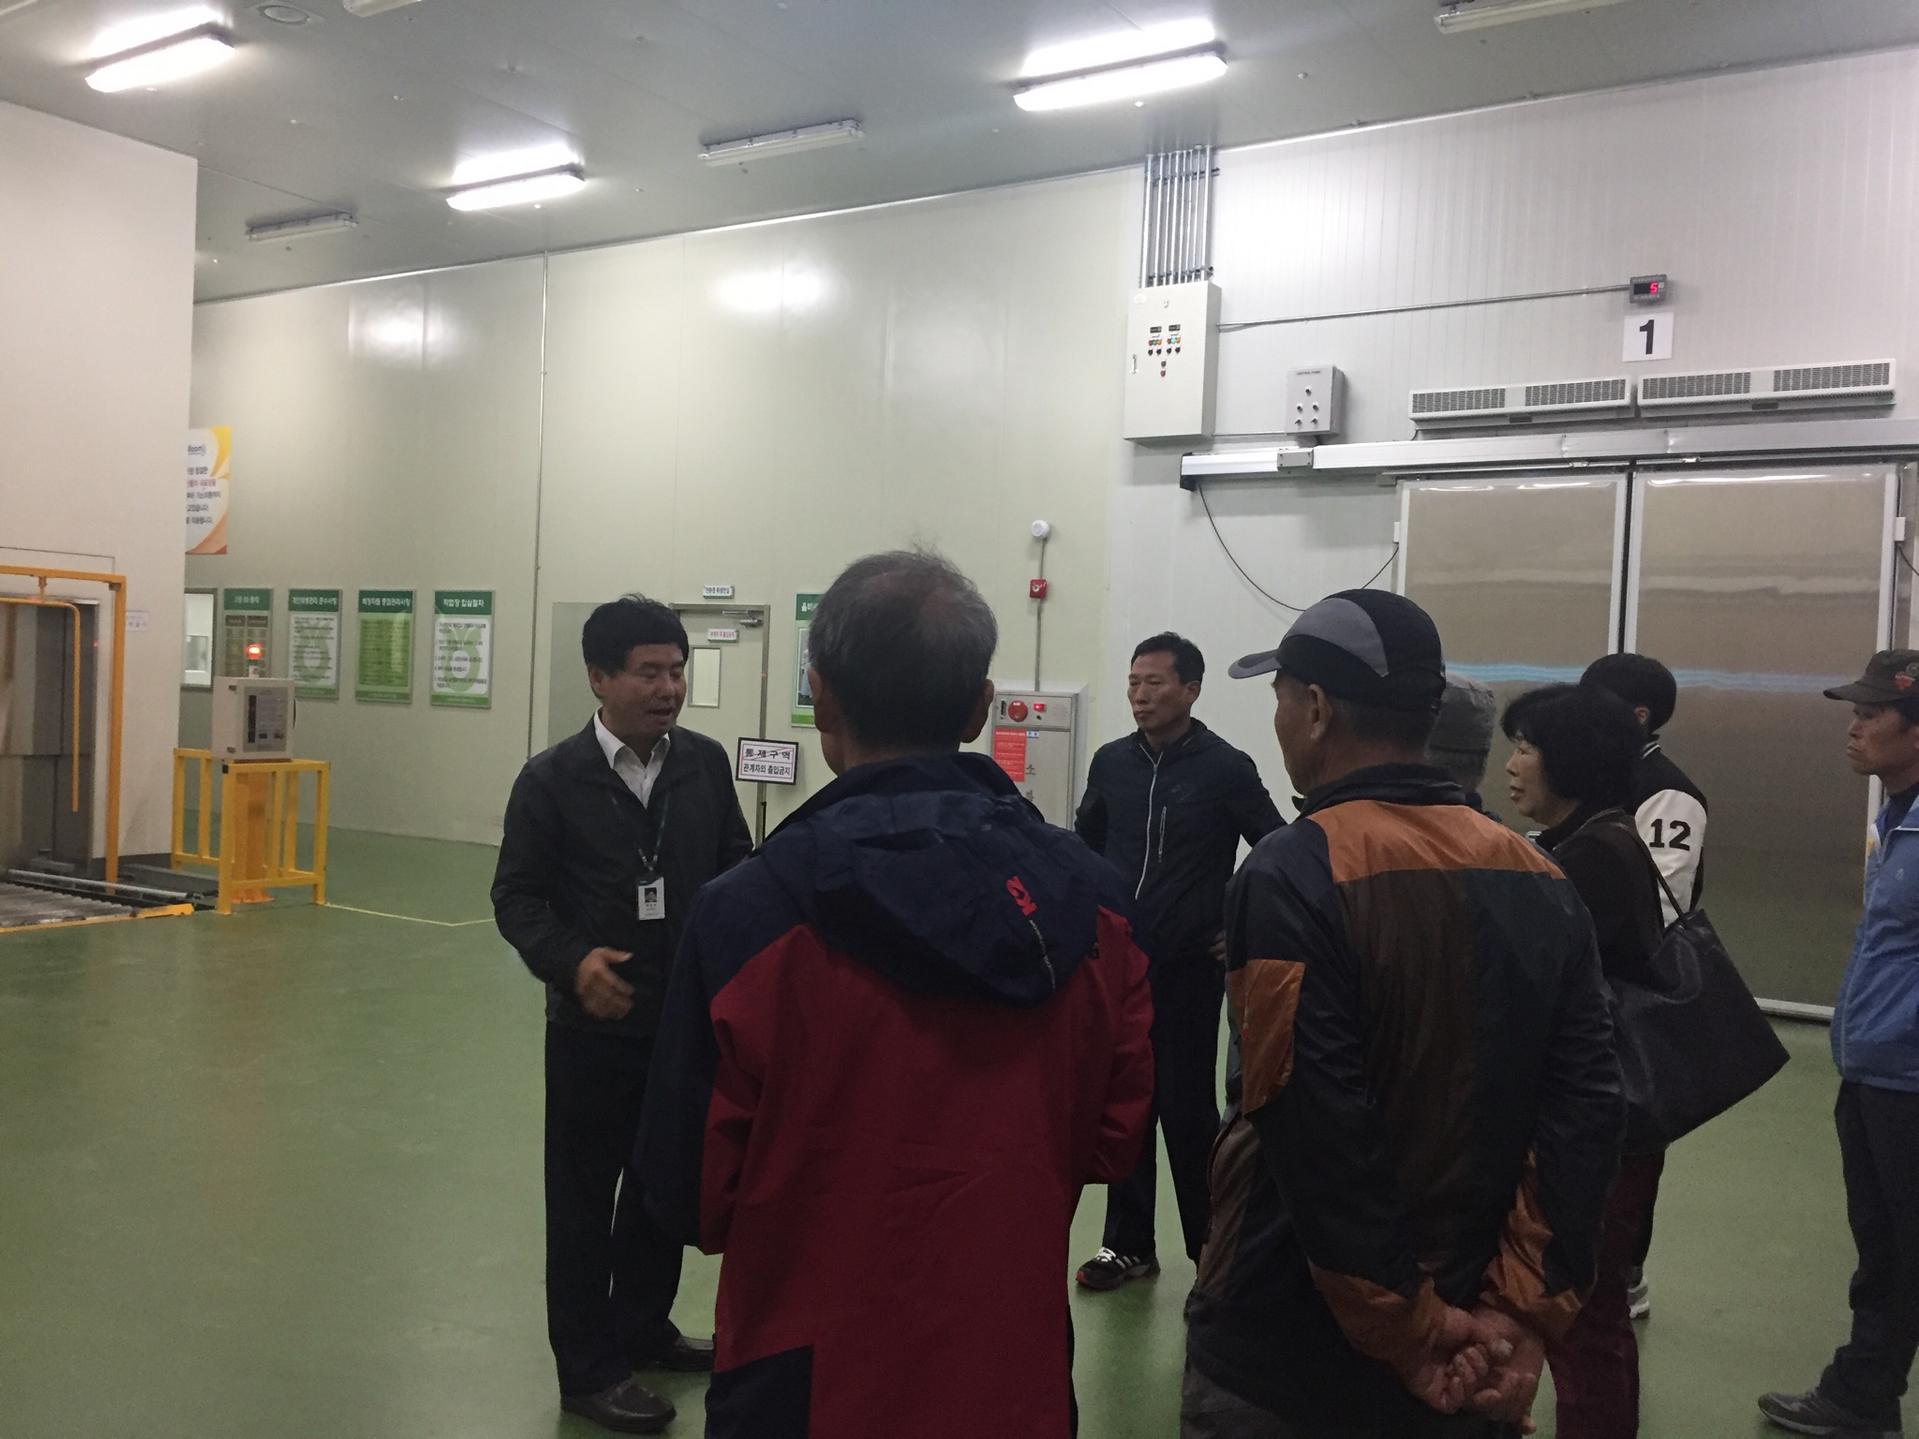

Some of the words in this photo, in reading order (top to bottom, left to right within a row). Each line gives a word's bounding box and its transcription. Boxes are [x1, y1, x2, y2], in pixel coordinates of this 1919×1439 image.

[1639, 319, 1655, 355] 1
[768, 765, 790, 776] 출입금지
[1649, 818, 1691, 851] 12
